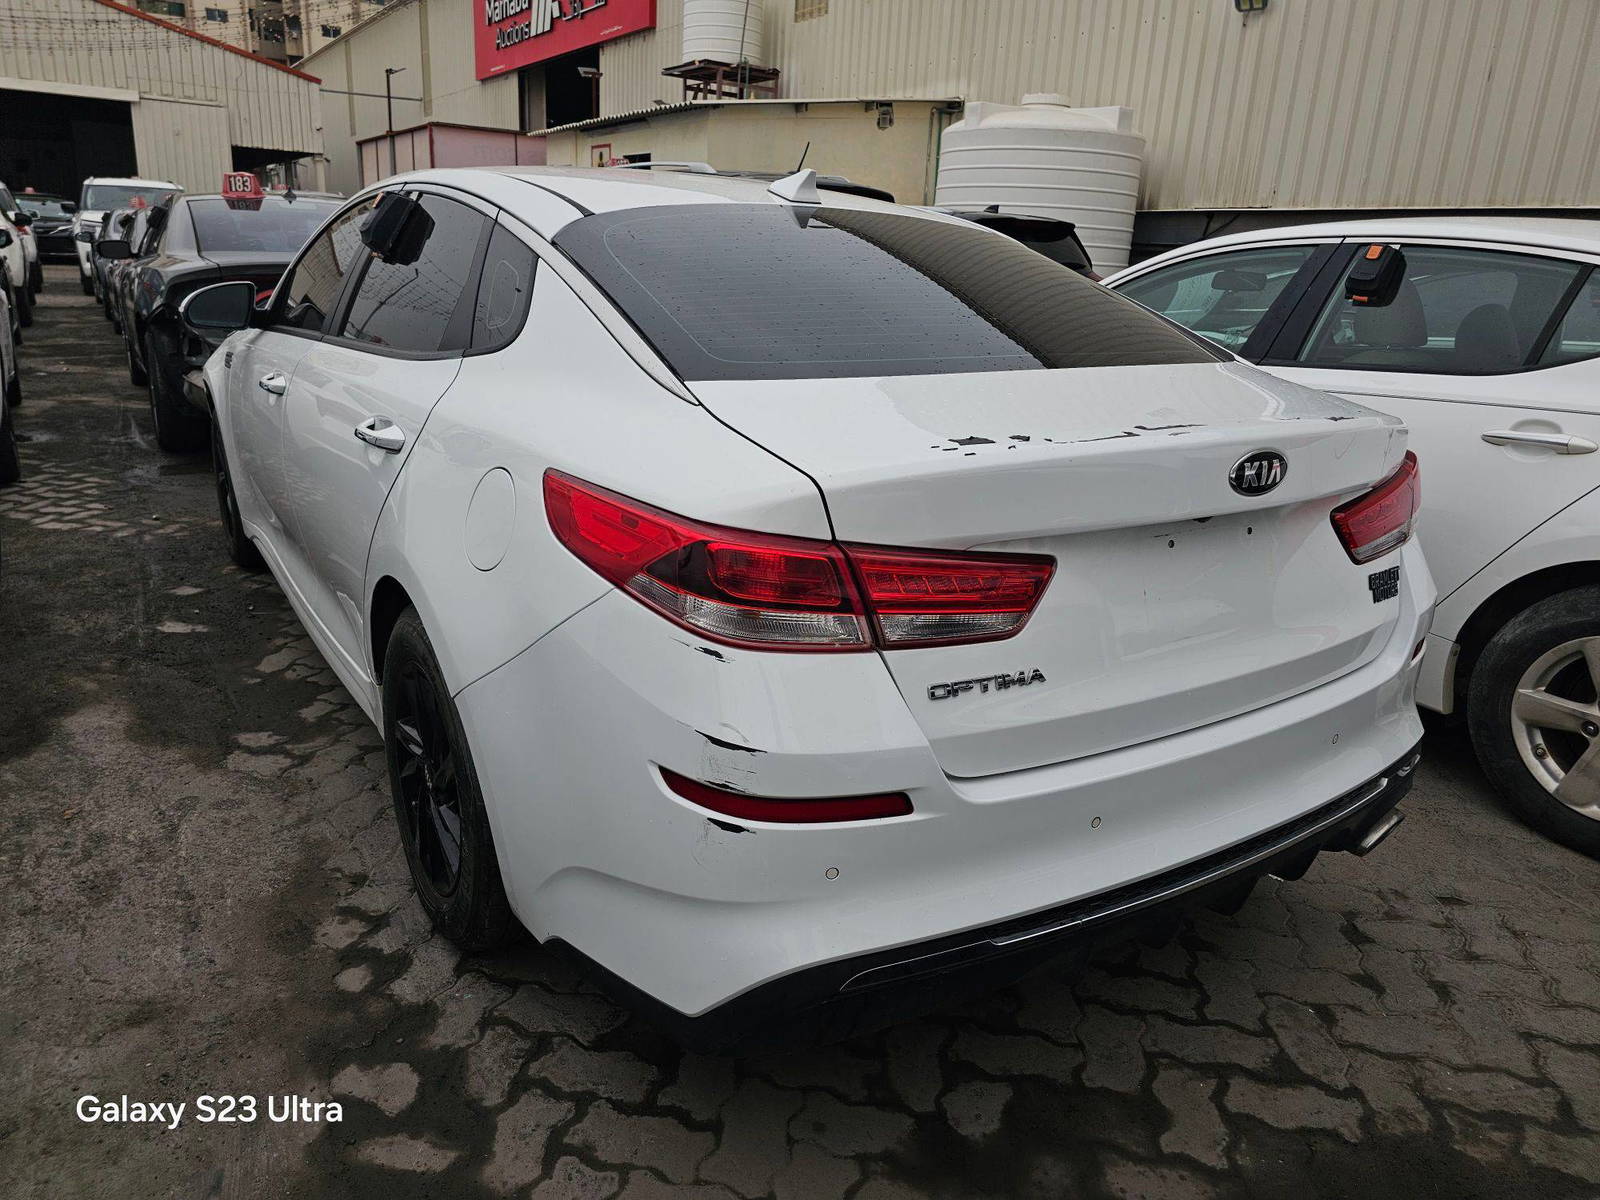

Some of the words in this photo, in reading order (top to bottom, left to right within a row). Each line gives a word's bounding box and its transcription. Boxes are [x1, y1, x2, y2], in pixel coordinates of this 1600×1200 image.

[496, 20, 530, 48] Auctions
[230, 176, 251, 192] 183
[1242, 459, 1281, 488] KIA
[927, 668, 1046, 700] OPTIMA
